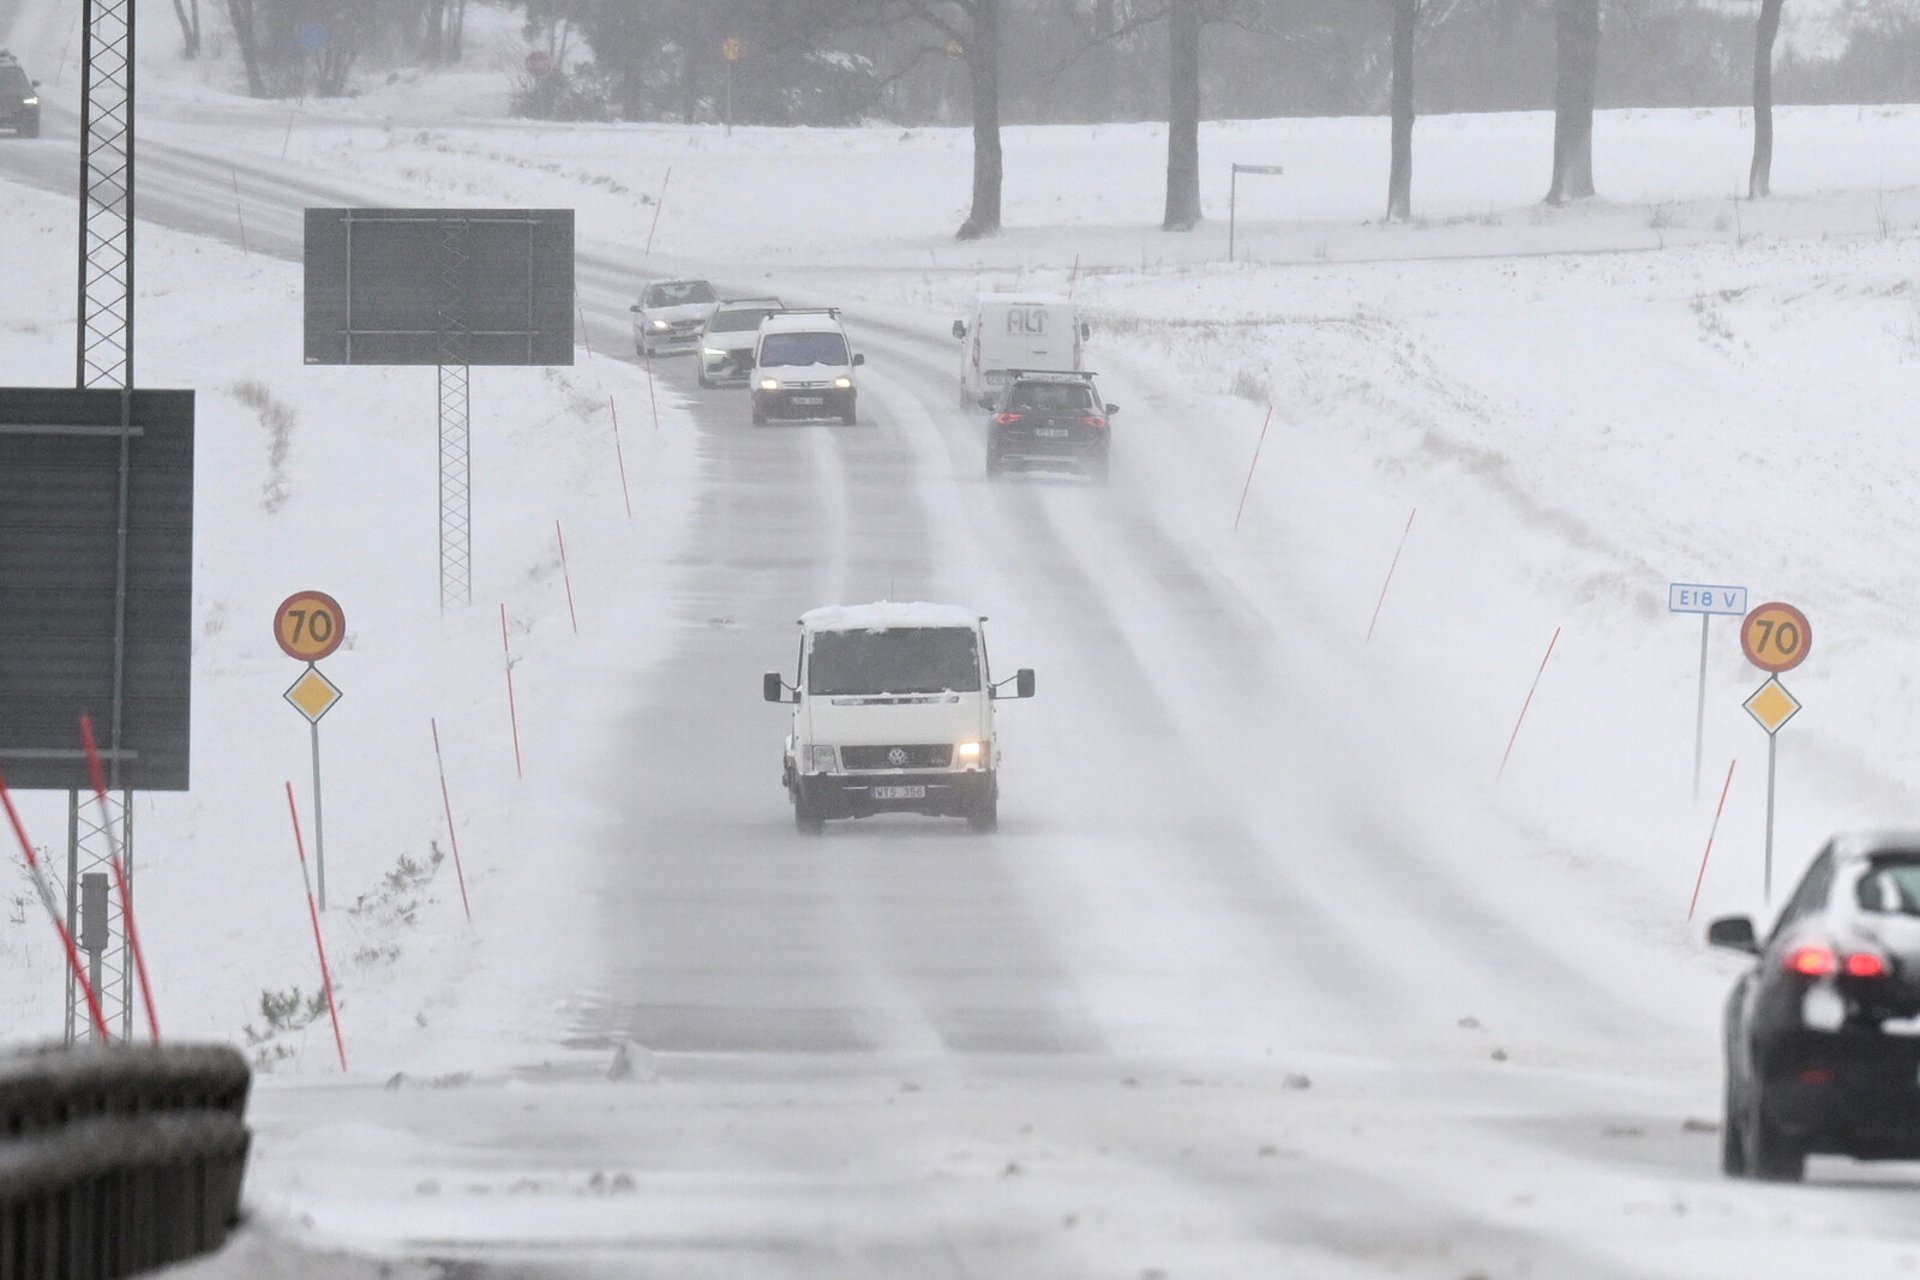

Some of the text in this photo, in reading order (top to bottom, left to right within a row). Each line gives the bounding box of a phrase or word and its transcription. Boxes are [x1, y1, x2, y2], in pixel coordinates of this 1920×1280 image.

[1008, 309, 1048, 333] ALT
[1680, 590, 1736, 608] E18 V
[287, 609, 332, 643] 70
[1756, 619, 1799, 655] 70
